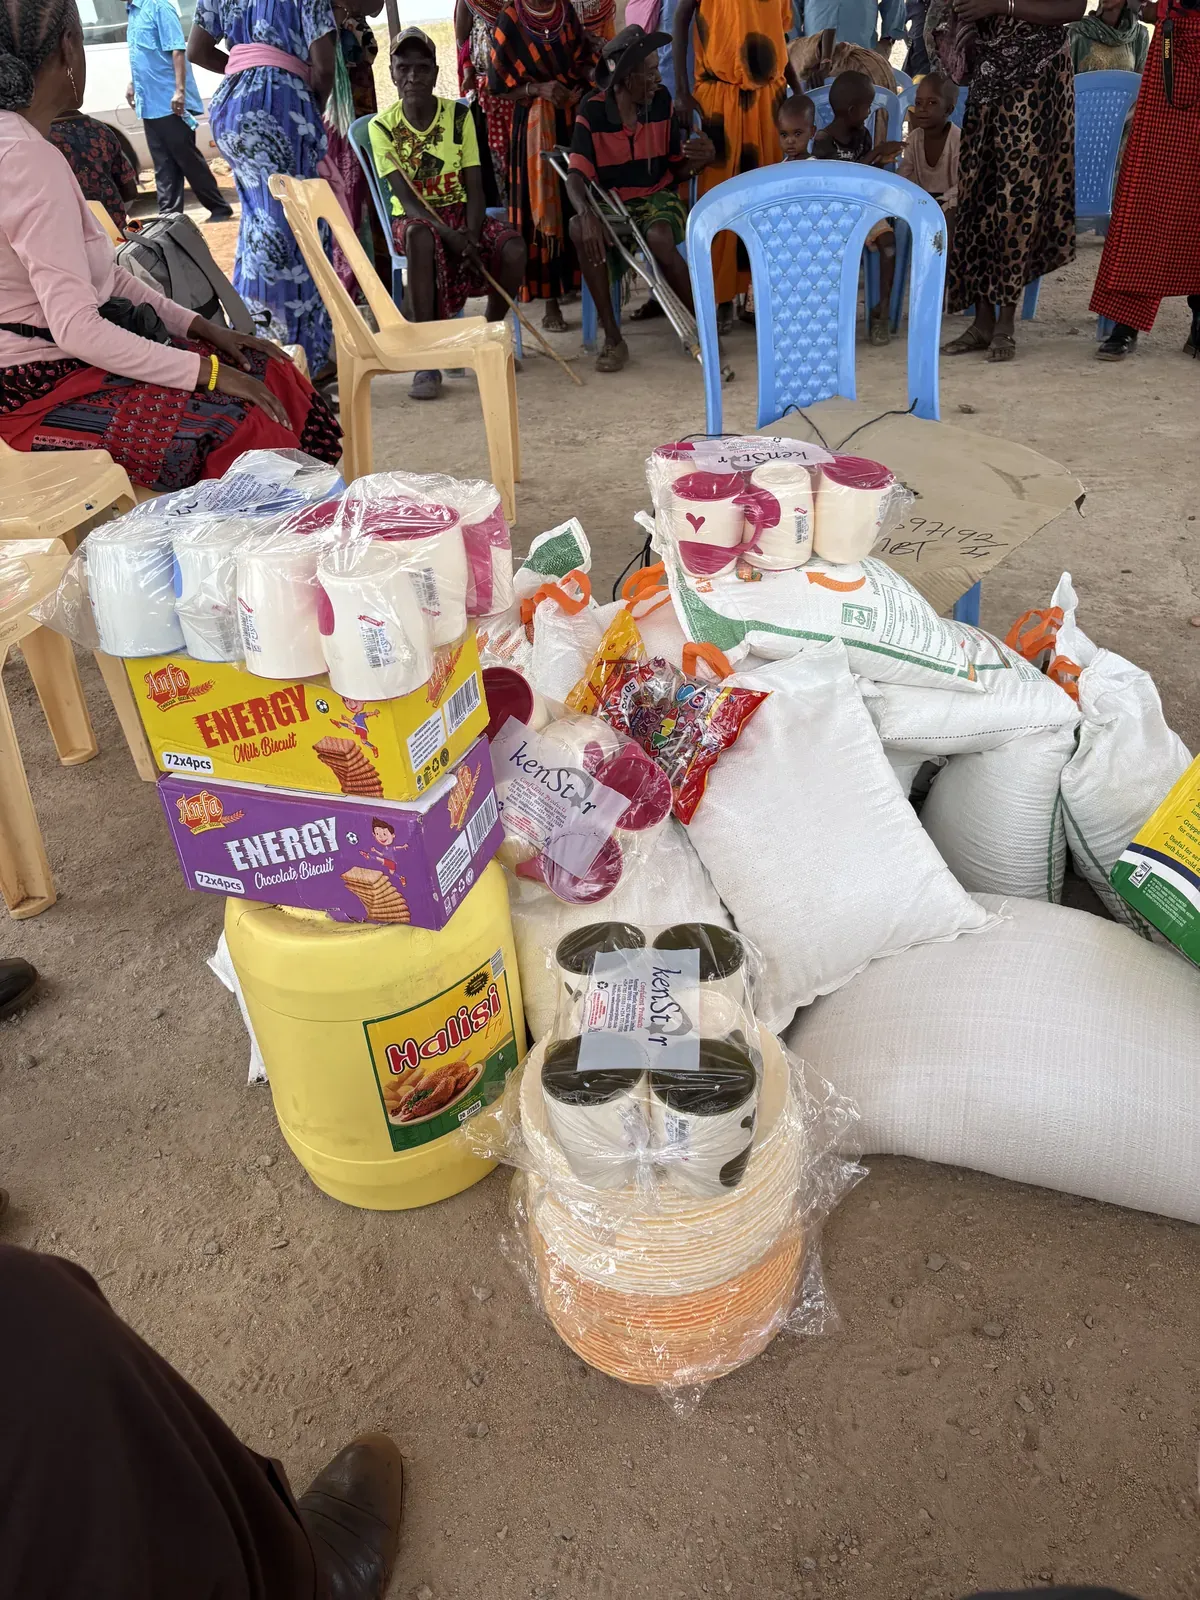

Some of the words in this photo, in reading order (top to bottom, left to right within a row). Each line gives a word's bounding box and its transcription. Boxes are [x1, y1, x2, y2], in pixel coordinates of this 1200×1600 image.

[144, 663, 190, 699] Anfa
[623, 681, 636, 693] 50
[192, 684, 310, 749] ENERGY
[165, 754, 212, 771] 72x4pcs
[233, 743, 260, 764] Milk
[261, 732, 297, 757] Biscuit
[175, 790, 223, 824] Anfa
[519, 775, 545, 796] Confident
[543, 793, 568, 813] Products
[223, 817, 340, 871] ENERGY
[1164, 841, 1176, 853] both
[1175, 849, 1196, 869] hot/cold
[1169, 834, 1186, 850] Useful
[1184, 847, 1192, 856] for
[197, 873, 242, 890] 72x4pcs
[254, 868, 298, 889] Chocolate
[299, 857, 334, 880] Biscuit
[386, 984, 501, 1074] Halisi
